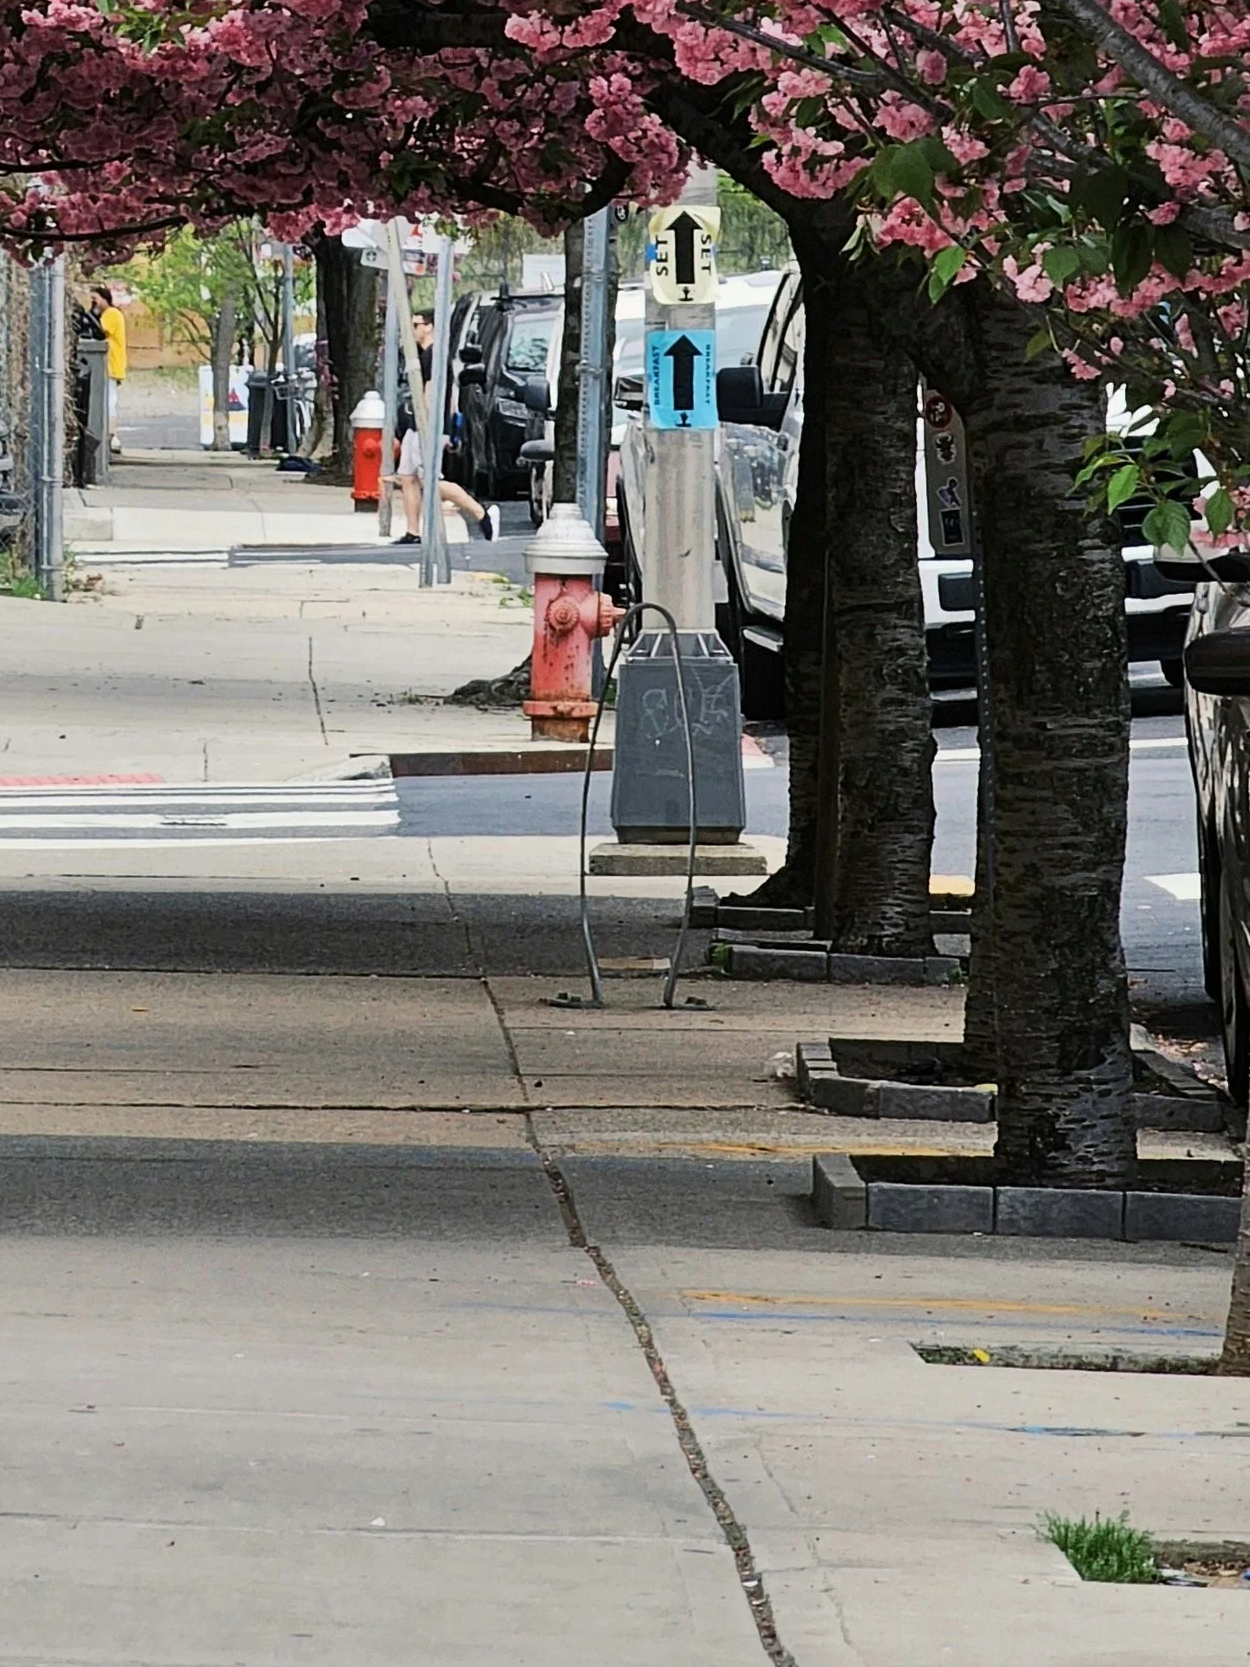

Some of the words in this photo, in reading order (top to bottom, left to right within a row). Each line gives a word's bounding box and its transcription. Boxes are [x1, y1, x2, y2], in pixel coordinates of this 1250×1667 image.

[655, 234, 669, 277] SET
[700, 234, 712, 276] SET
[652, 345, 661, 406] BREAKFAST
